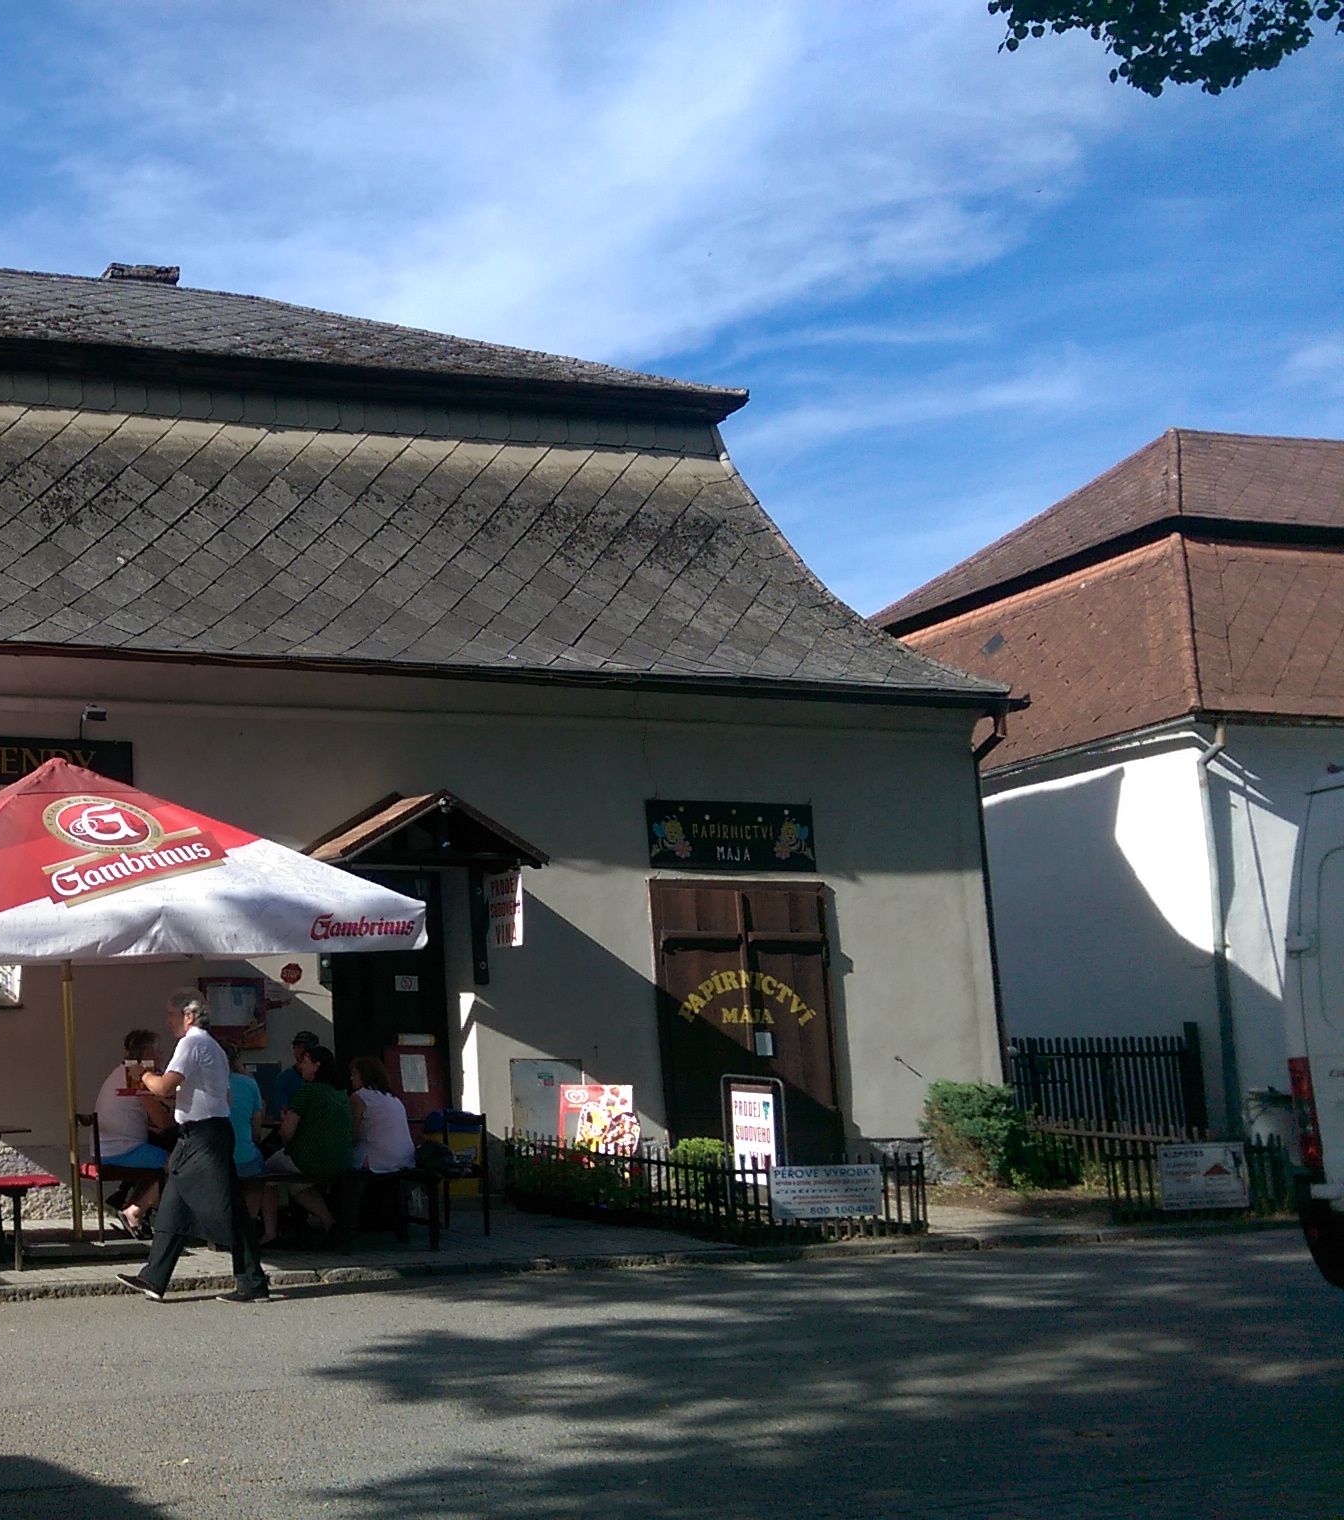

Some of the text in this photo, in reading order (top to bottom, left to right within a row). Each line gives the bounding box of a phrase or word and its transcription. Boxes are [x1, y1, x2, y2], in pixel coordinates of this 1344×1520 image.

[691, 822, 774, 841] PAPÍRNICTVÍ
[51, 841, 212, 896] Gambrinus
[490, 877, 518, 897] PRODEJ
[310, 912, 416, 941] Gambrinus
[495, 920, 517, 945] VÍNA
[282, 969, 300, 979] STOP
[677, 969, 817, 1027] PAPÍRNICTVÍ
[721, 1004, 775, 1024] MÁJA
[734, 1100, 760, 1117] PRODEJ
[736, 1123, 771, 1144] SUDOVÉHO
